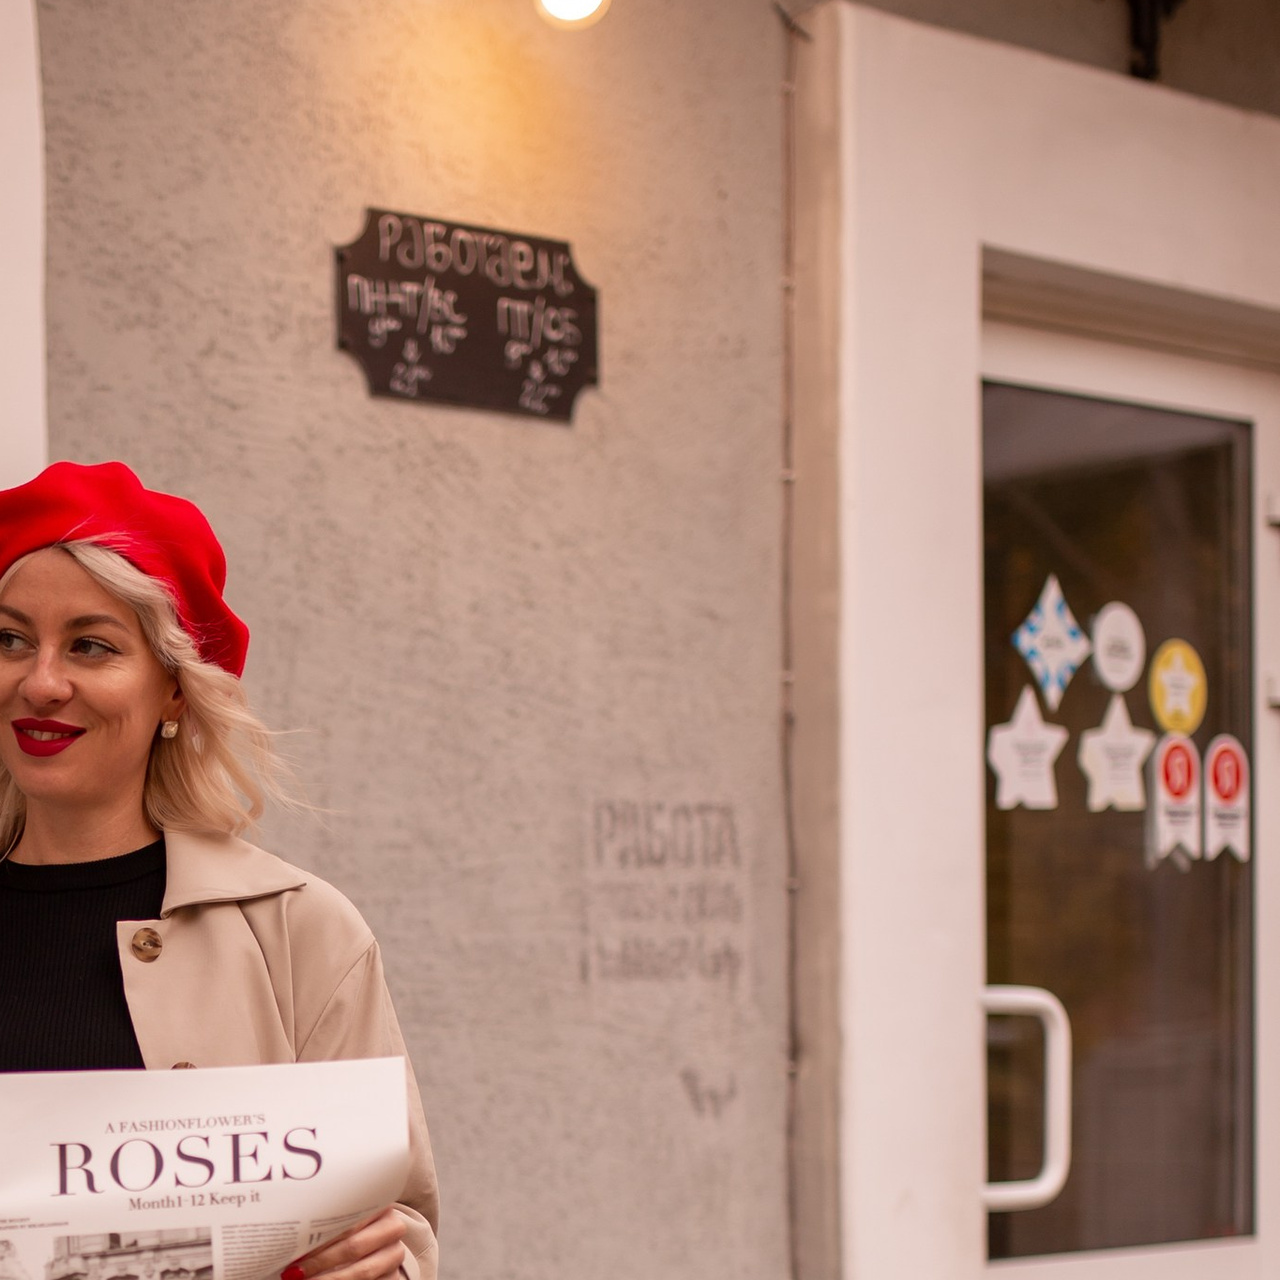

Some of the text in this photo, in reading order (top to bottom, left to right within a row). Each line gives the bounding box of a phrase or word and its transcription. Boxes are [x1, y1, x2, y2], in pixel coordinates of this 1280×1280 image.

[105, 1123, 115, 1134] A
[50, 1126, 323, 1197] ROSES
[210, 1192, 244, 1209] Keep
[249, 1191, 260, 1204] it
